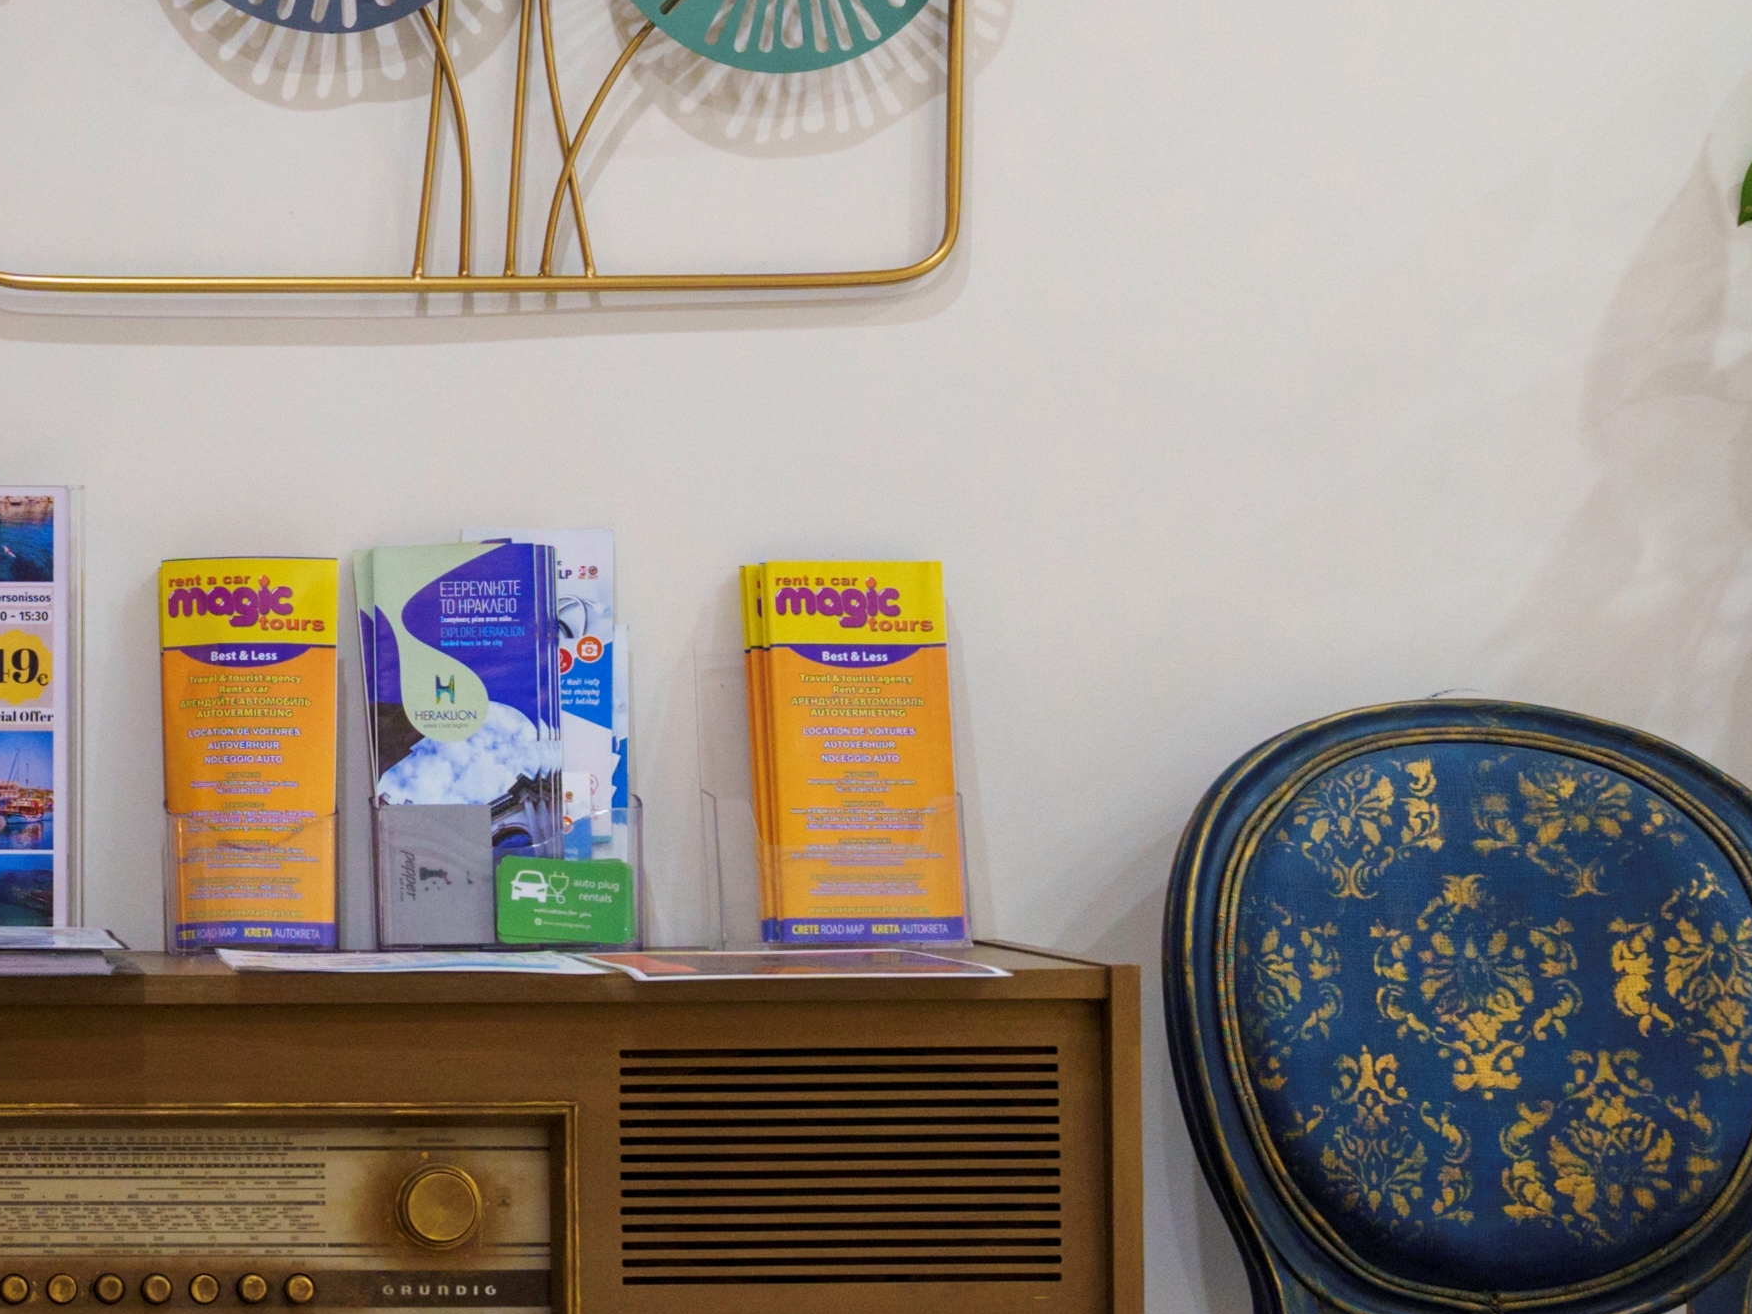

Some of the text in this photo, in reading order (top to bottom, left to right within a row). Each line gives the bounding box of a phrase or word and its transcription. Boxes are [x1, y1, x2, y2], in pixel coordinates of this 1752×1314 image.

[168, 575, 250, 587] rent a car
[775, 575, 857, 586] rent a car
[440, 580, 521, 597] ΕΞΕΡΕΥΝΗΣΤΕ
[168, 575, 294, 627] magic
[441, 598, 517, 614] ΤΟ ΗΡΑΚΛΕΙΟ
[775, 577, 900, 628] magic
[20, 611, 49, 621] 15:30
[259, 615, 325, 631] tours
[868, 618, 933, 632] tours
[441, 625, 525, 638] EXPLORE HERAKLION
[211, 651, 277, 661] Best & Less
[822, 651, 888, 662] Best & Less
[189, 675, 217, 683] Travel
[229, 674, 263, 682] tourist
[265, 676, 301, 684] agency
[799, 674, 913, 684] Travel & tourist agency
[219, 686, 243, 694] Rent
[833, 686, 856, 694] Rent
[866, 686, 881, 694] car
[20, 711, 54, 723] Offer
[197, 709, 293, 718] AUTOVERMIETUNG
[415, 710, 477, 721] HERAKLION
[810, 709, 906, 718] AUTOVERMIETUNG
[188, 728, 234, 737] LOCATION
[253, 728, 301, 736] VOITURES
[802, 727, 915, 735] LOCATION DE VOITURES
[207, 742, 280, 750] AUTOVERHUUR
[824, 741, 895, 749] AUTOVERHUUR
[205, 755, 283, 764] NOLEGGIO AUTO
[821, 754, 900, 763] NOLEGGIO AUTO
[400, 849, 416, 901] pepper
[573, 878, 620, 893] auto plug
[578, 893, 612, 904] rentals
[197, 928, 218, 938] ROAD
[219, 927, 237, 938] MAP
[244, 928, 273, 938] KRETA
[274, 928, 320, 939] AUTOKRETA
[792, 924, 949, 935] CRETE ROAD MAP KRETA AUTOKRETA
[383, 1285, 497, 1296] GRUNDIG
